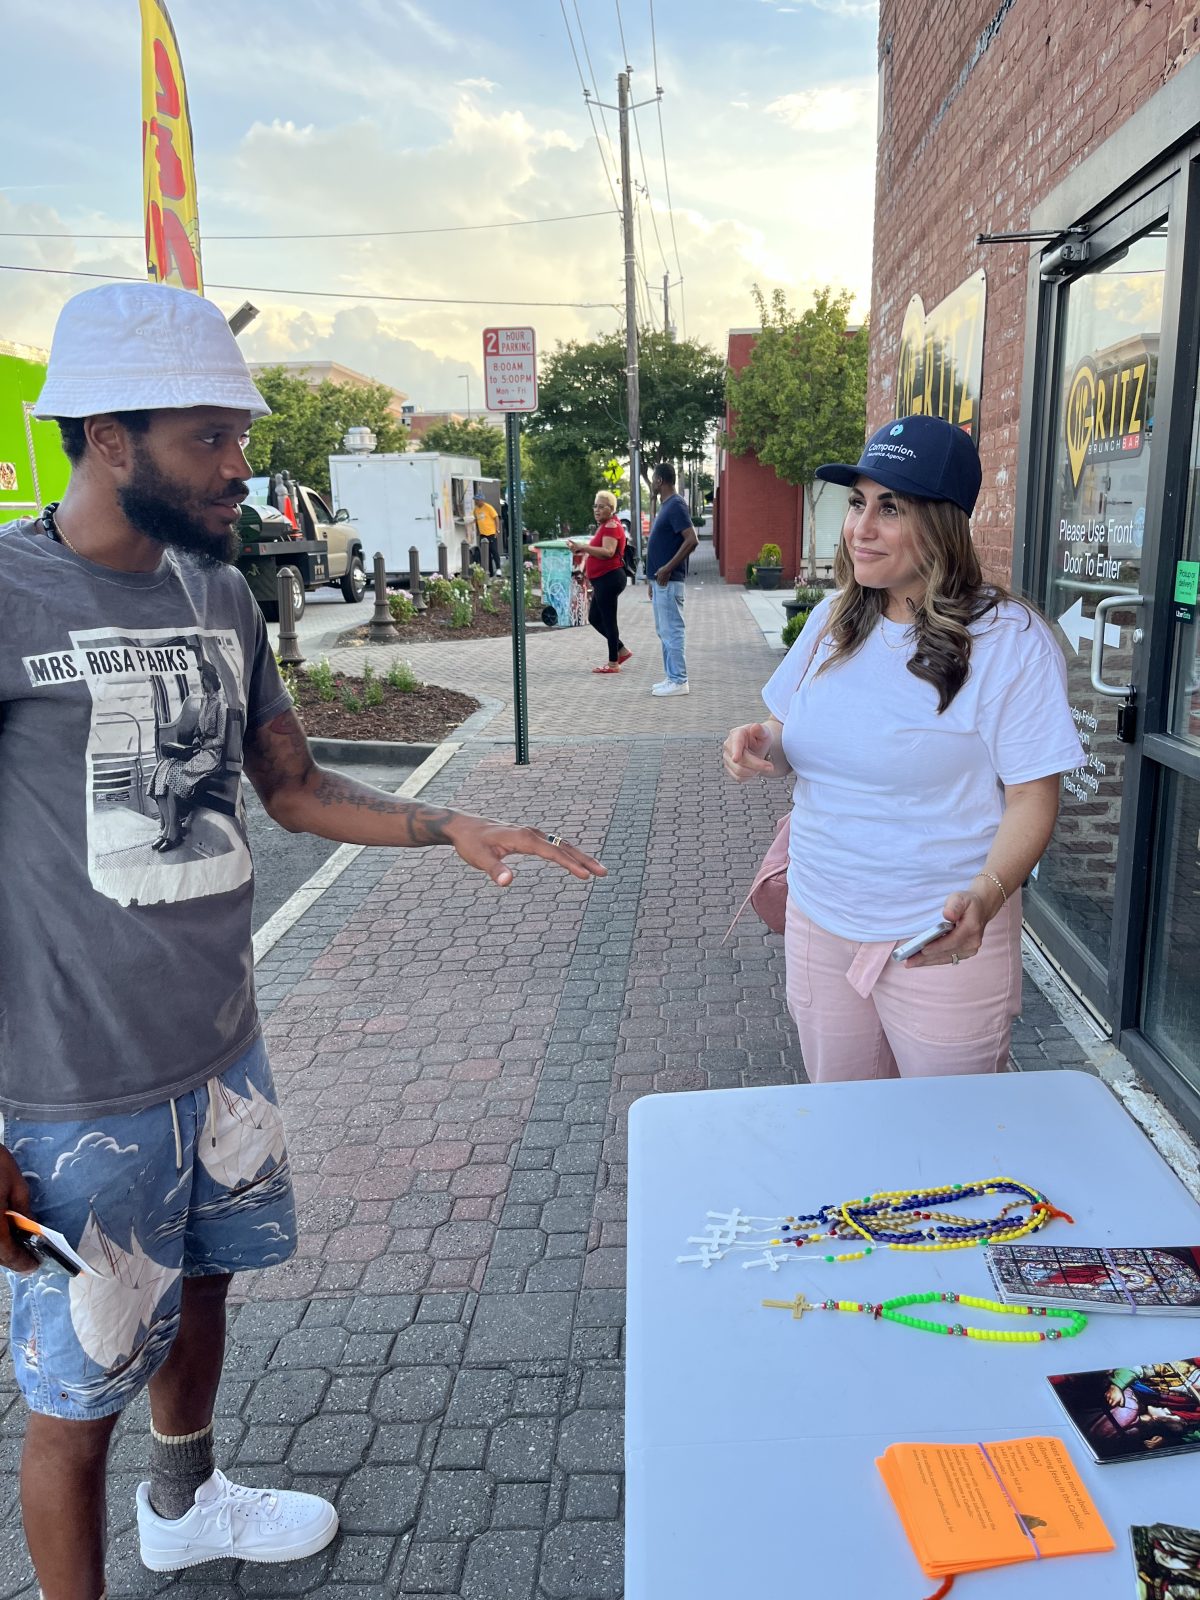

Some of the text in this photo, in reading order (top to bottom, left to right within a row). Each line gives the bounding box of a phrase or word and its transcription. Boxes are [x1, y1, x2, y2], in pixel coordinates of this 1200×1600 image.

[486, 332, 497, 353] 2
[505, 331, 525, 341] HOUR
[501, 342, 531, 353] PARKING
[493, 362, 524, 371] 8:00AM
[489, 374, 532, 384] to 5:00PM
[495, 387, 509, 395] Mon
[517, 387, 527, 395] Fri
[1066, 364, 1146, 454] GRITZ
[868, 443, 914, 457] Comparion
[1122, 435, 1140, 449] BAR
[885, 452, 906, 462] Agency
[1059, 518, 1086, 542] Please
[1087, 518, 1106, 543] Use
[1107, 519, 1134, 544] Front
[1063, 550, 1122, 580] Door To Enter
[28, 648, 189, 682] MRS. ROSA PARKS
[1064, 775, 1087, 802] 10am-6pm
[1080, 767, 1100, 794] Sunday
[1024, 1442, 1042, 1466] Church?
[1047, 1440, 1061, 1456] Want
[1058, 1464, 1073, 1480] learn
[1067, 1481, 1080, 1496] more
[1075, 1497, 1091, 1515] about
[1049, 1470, 1063, 1485] Jesus
[1061, 1493, 1072, 1503] the
[1066, 1504, 1086, 1529] Catholic
